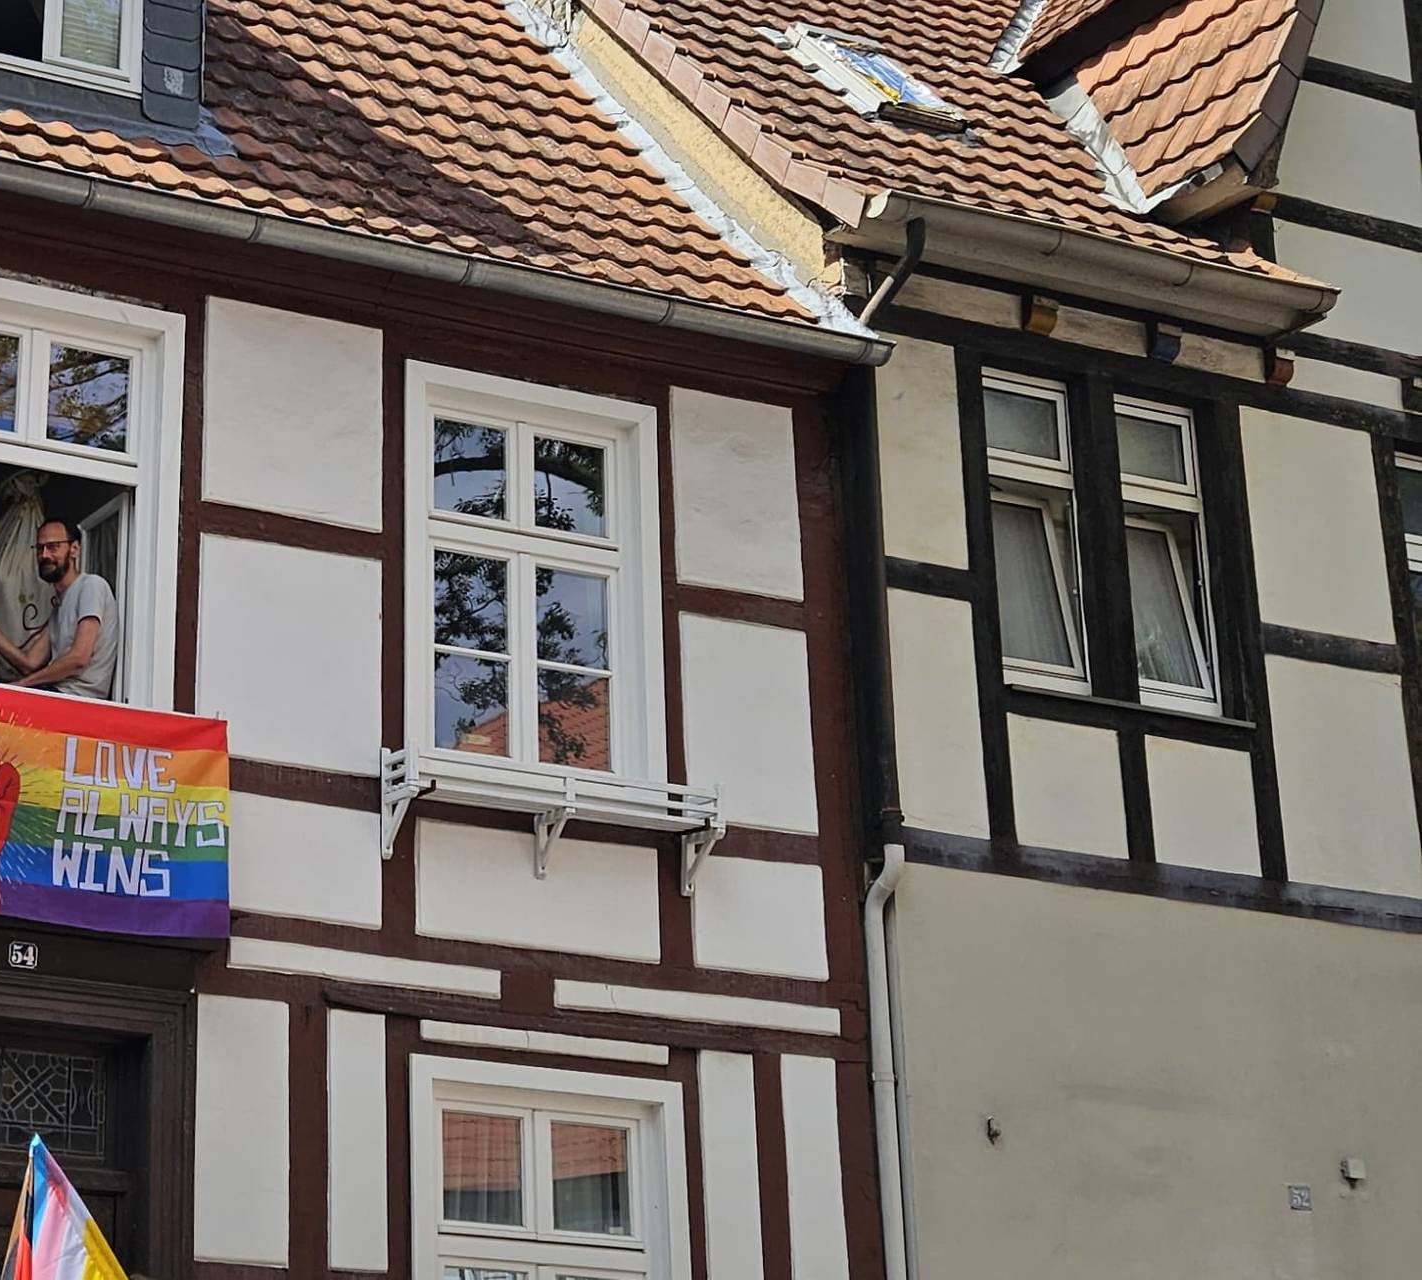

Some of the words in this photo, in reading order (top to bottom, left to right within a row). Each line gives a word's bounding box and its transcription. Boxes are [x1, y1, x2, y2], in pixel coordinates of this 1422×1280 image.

[65, 736, 176, 793] LOVE
[56, 787, 225, 848] ALWAYS
[52, 839, 170, 897] WINS
[11, 944, 35, 966] 54
[1292, 1190, 1310, 1207] 52
